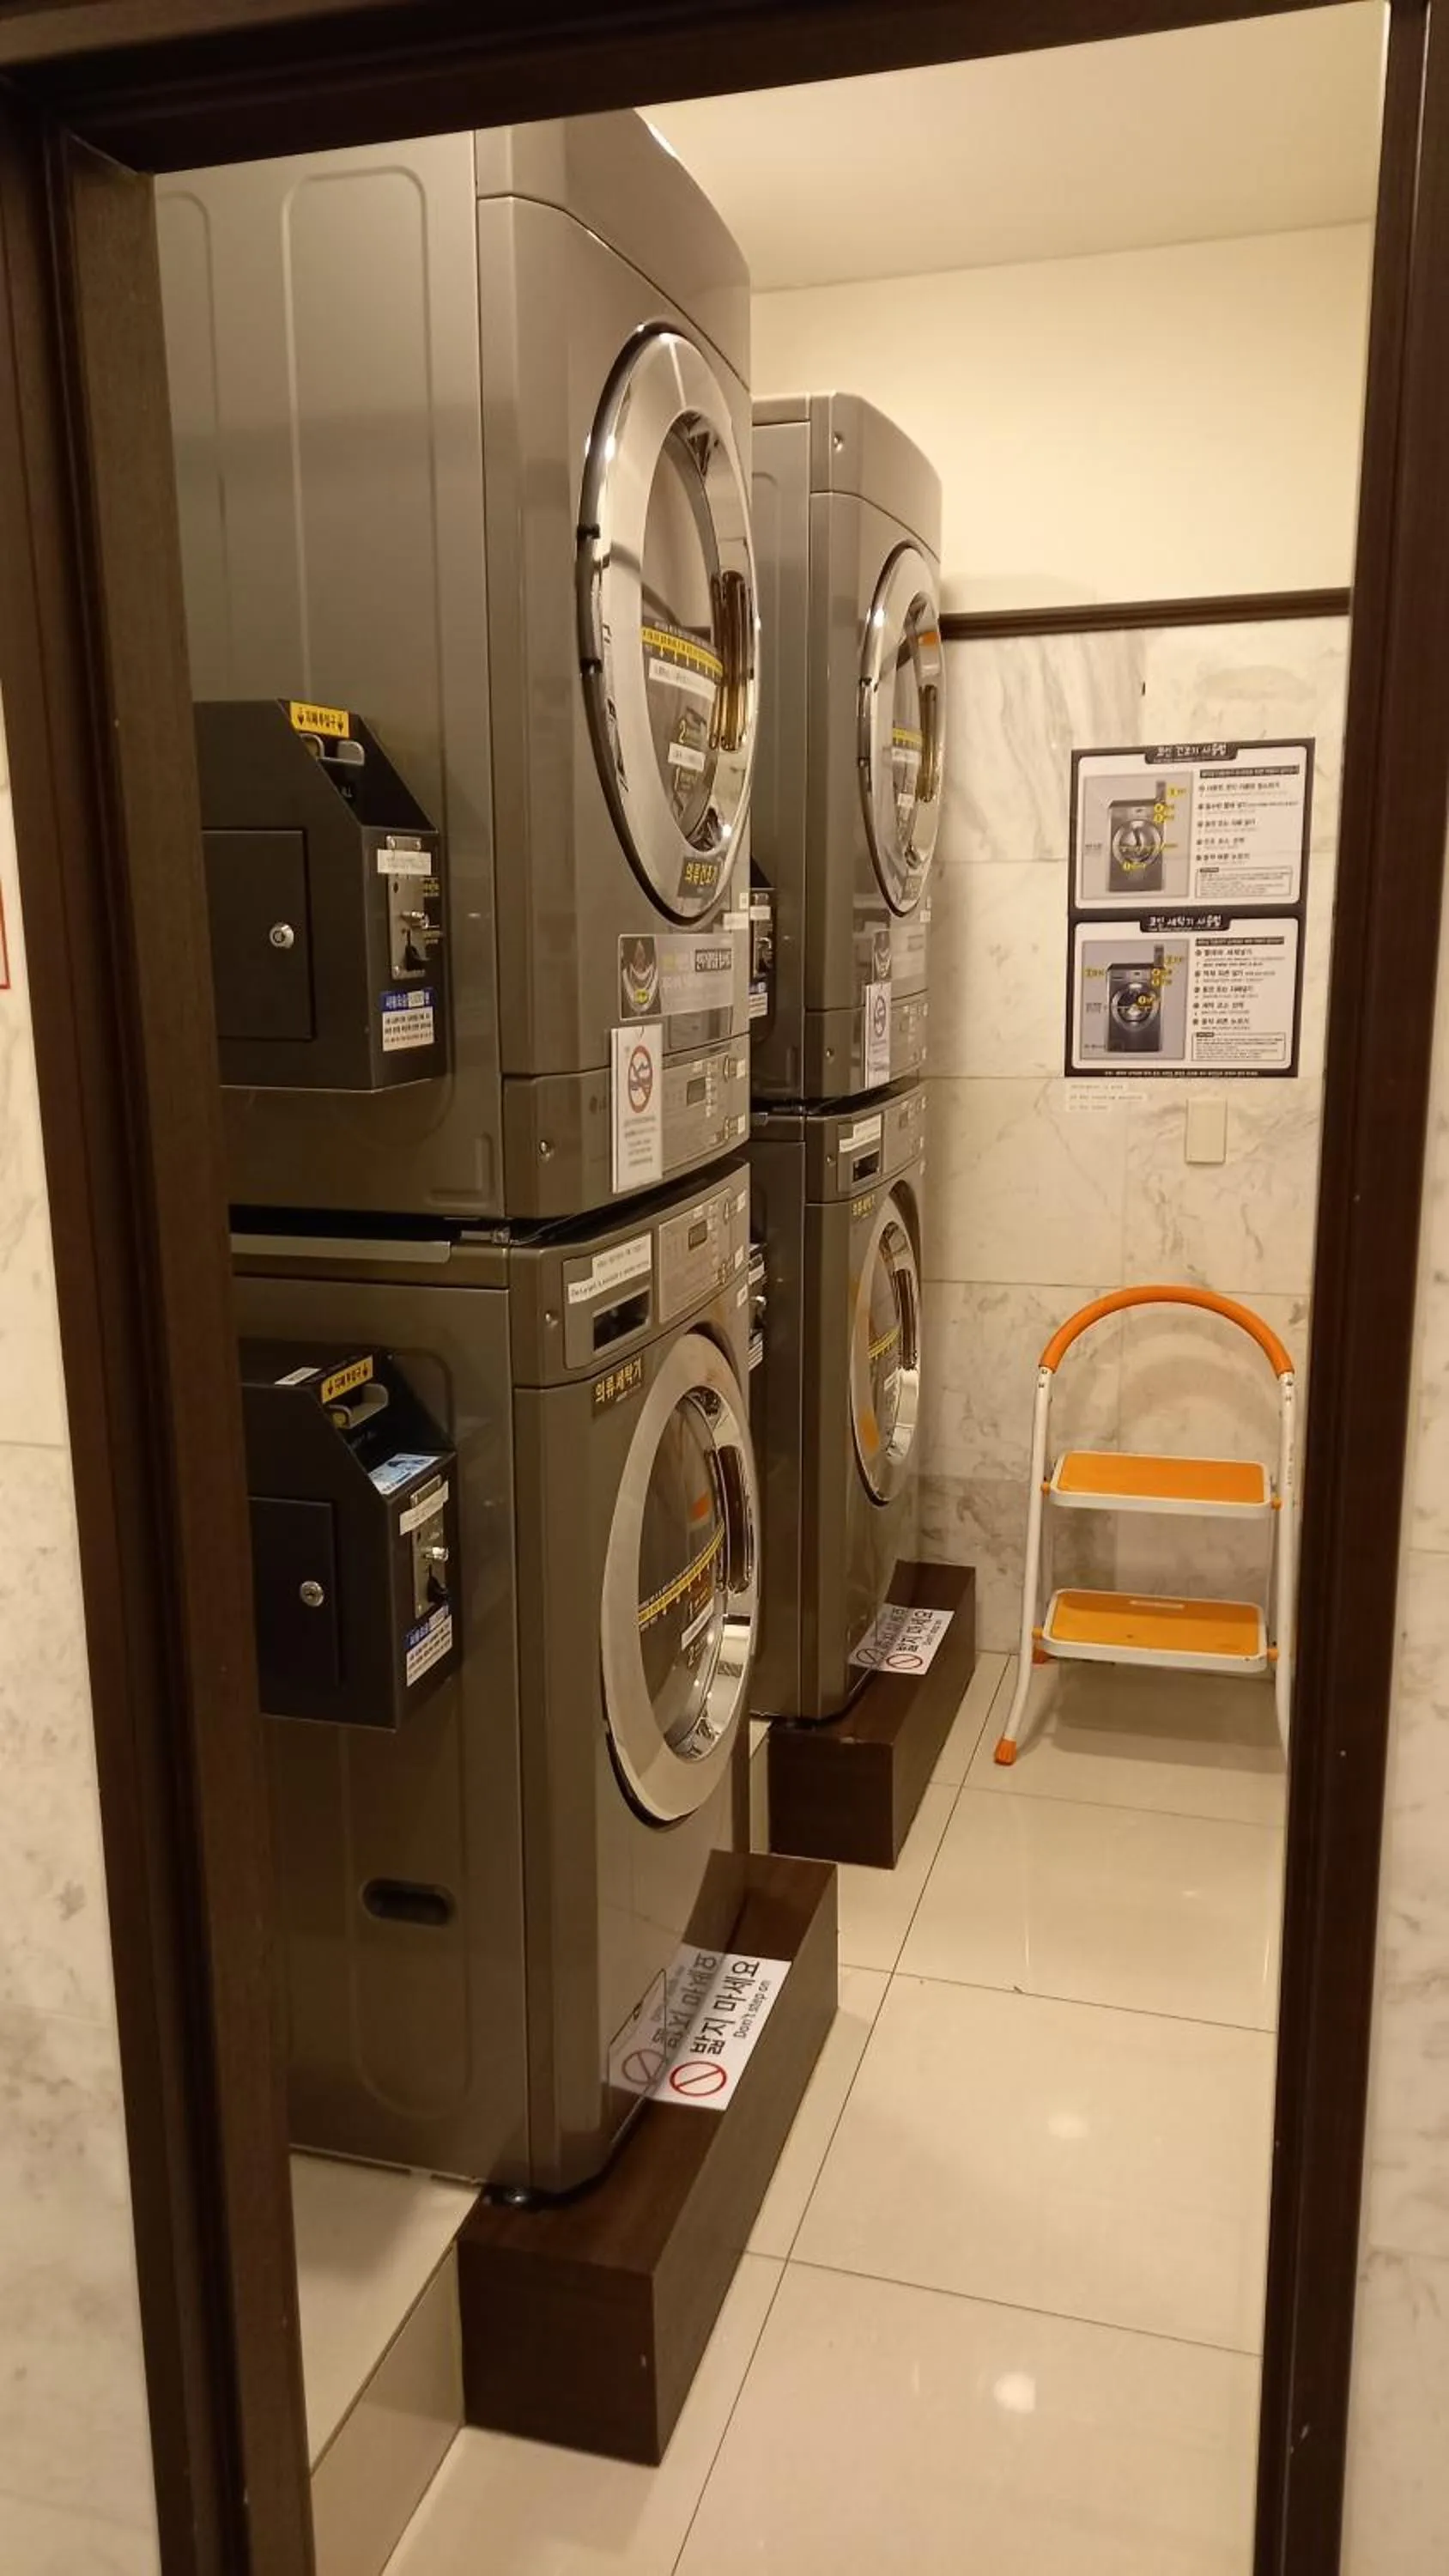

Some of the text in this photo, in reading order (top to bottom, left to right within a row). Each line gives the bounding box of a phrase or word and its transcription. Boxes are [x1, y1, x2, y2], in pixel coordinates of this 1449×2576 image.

[594, 1358, 643, 1403] 의류세탁기
[689, 1960, 760, 2055] 밟지 마세요
